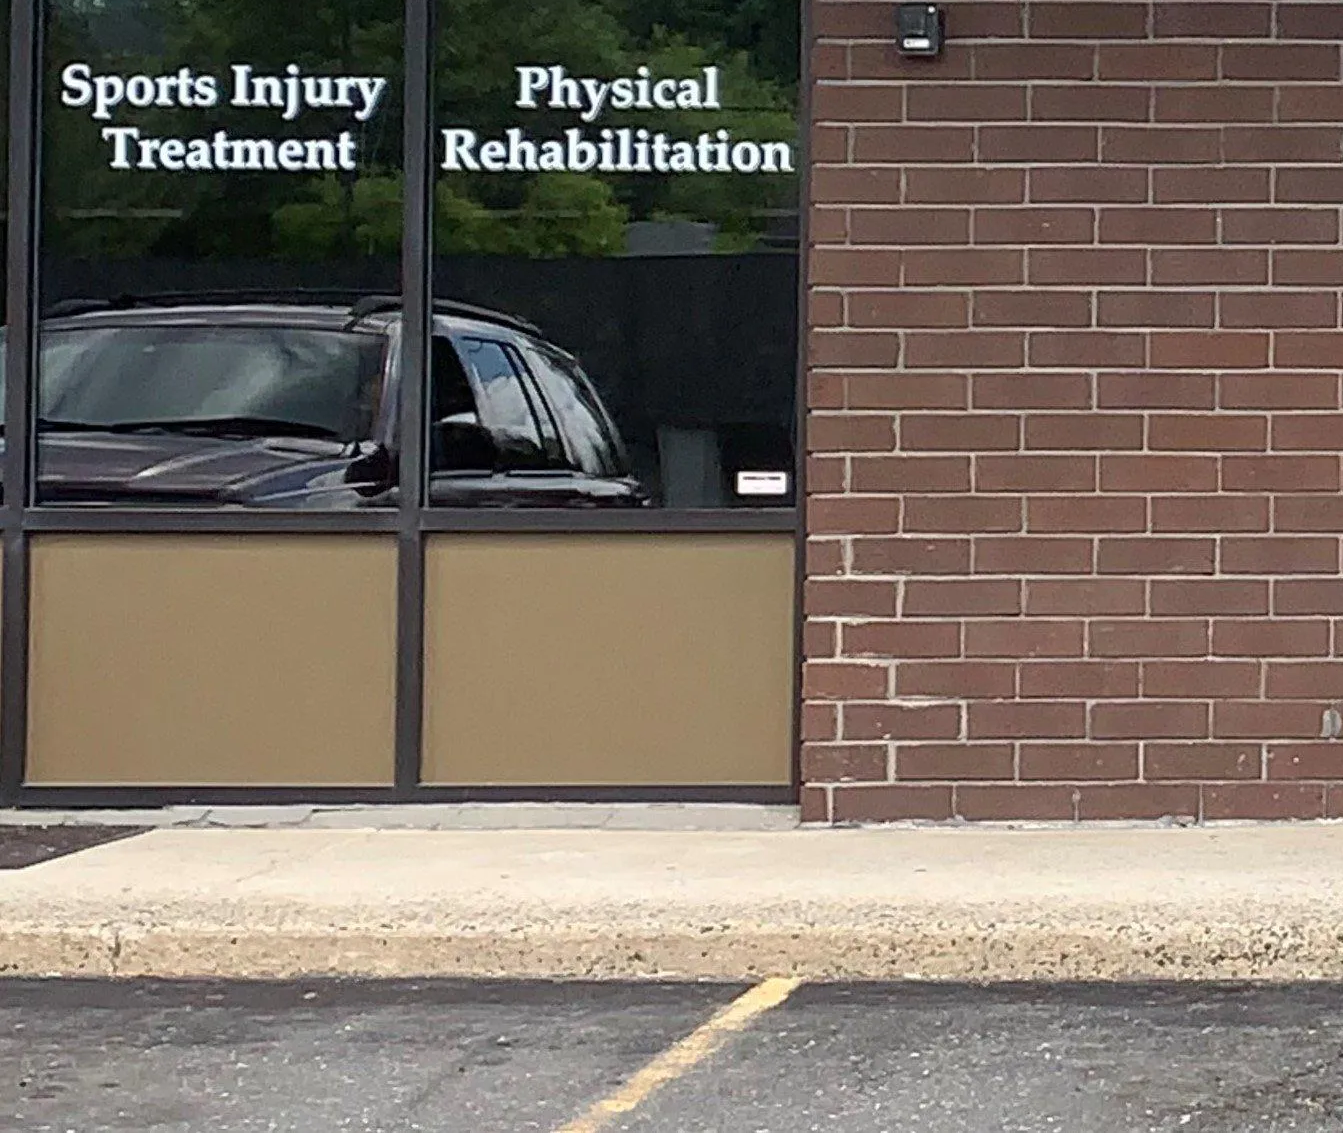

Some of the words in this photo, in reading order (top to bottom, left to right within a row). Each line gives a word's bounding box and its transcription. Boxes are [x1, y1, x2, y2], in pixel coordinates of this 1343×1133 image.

[61, 63, 218, 119] Sports
[230, 64, 386, 121] Injury
[514, 66, 720, 121] Physical
[101, 127, 357, 171] Treatment
[441, 128, 796, 173] Rehabilitation
